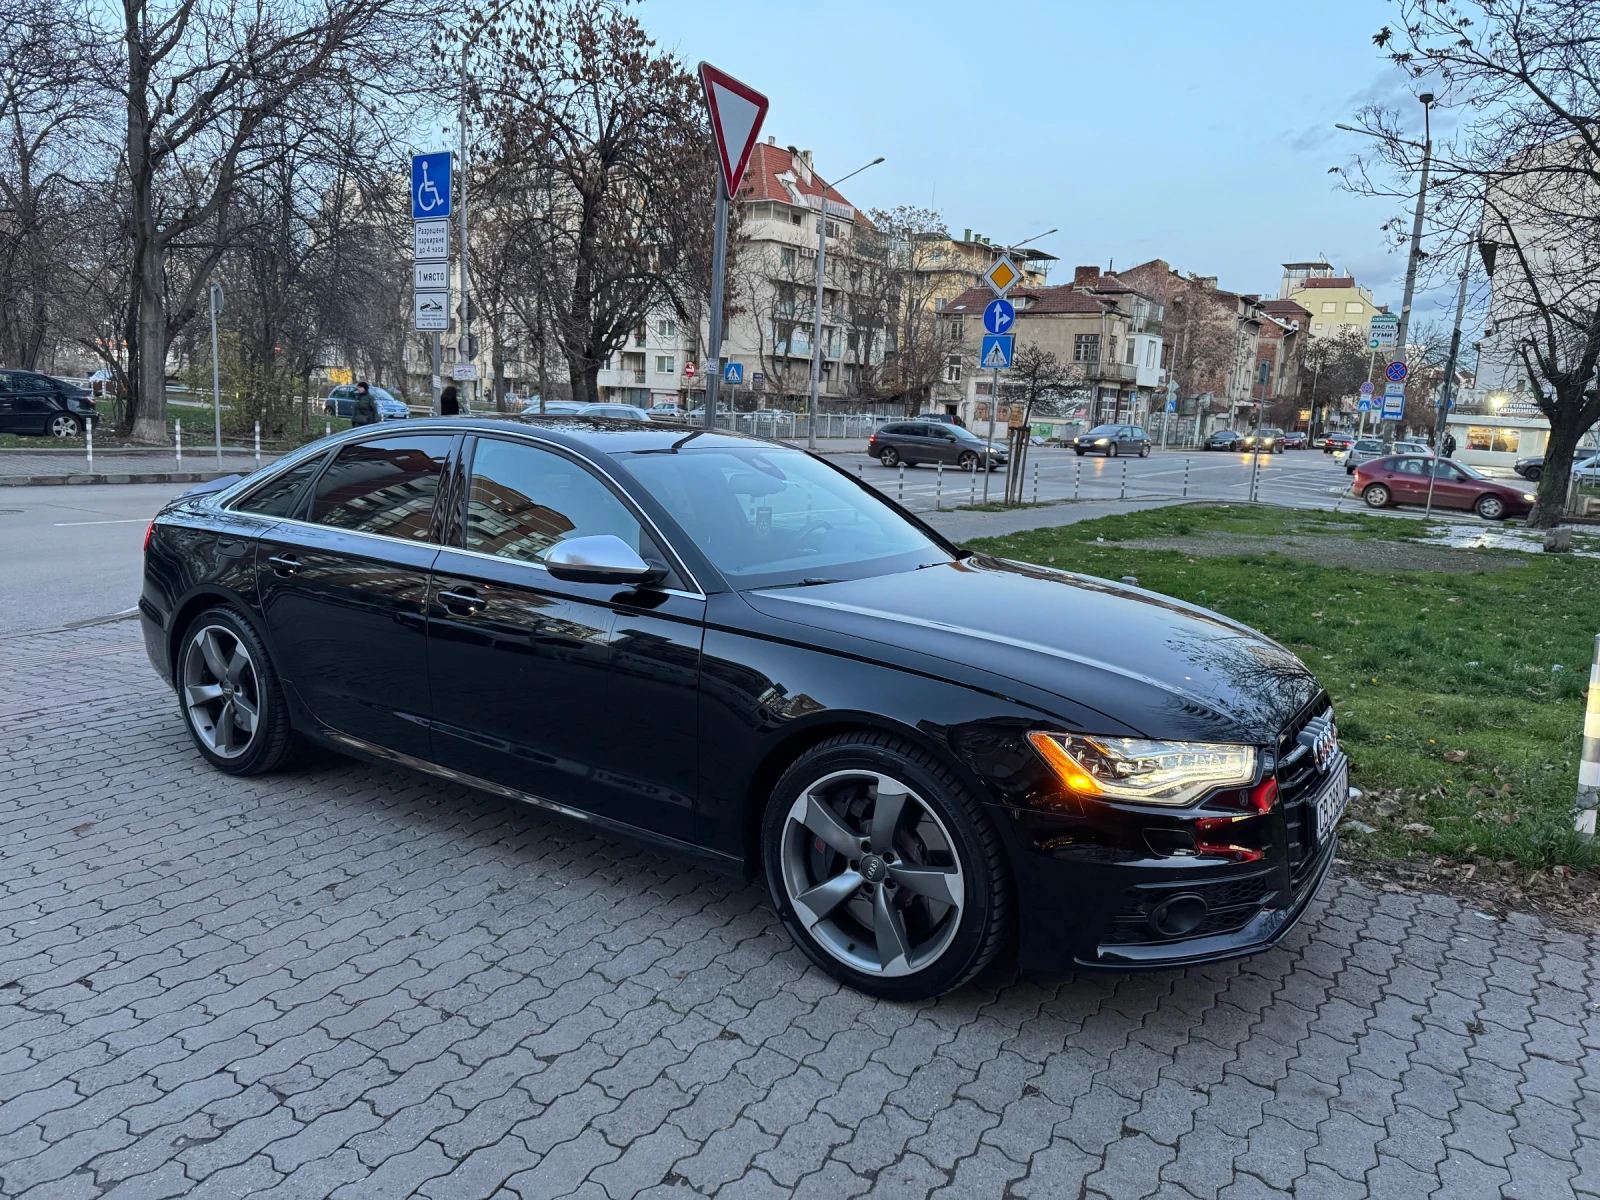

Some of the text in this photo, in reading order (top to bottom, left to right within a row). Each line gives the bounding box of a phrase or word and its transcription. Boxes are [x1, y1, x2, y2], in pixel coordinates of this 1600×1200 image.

[418, 227, 445, 236] Разрешено
[418, 237, 444, 245] паркиране
[419, 271, 422, 281] 1
